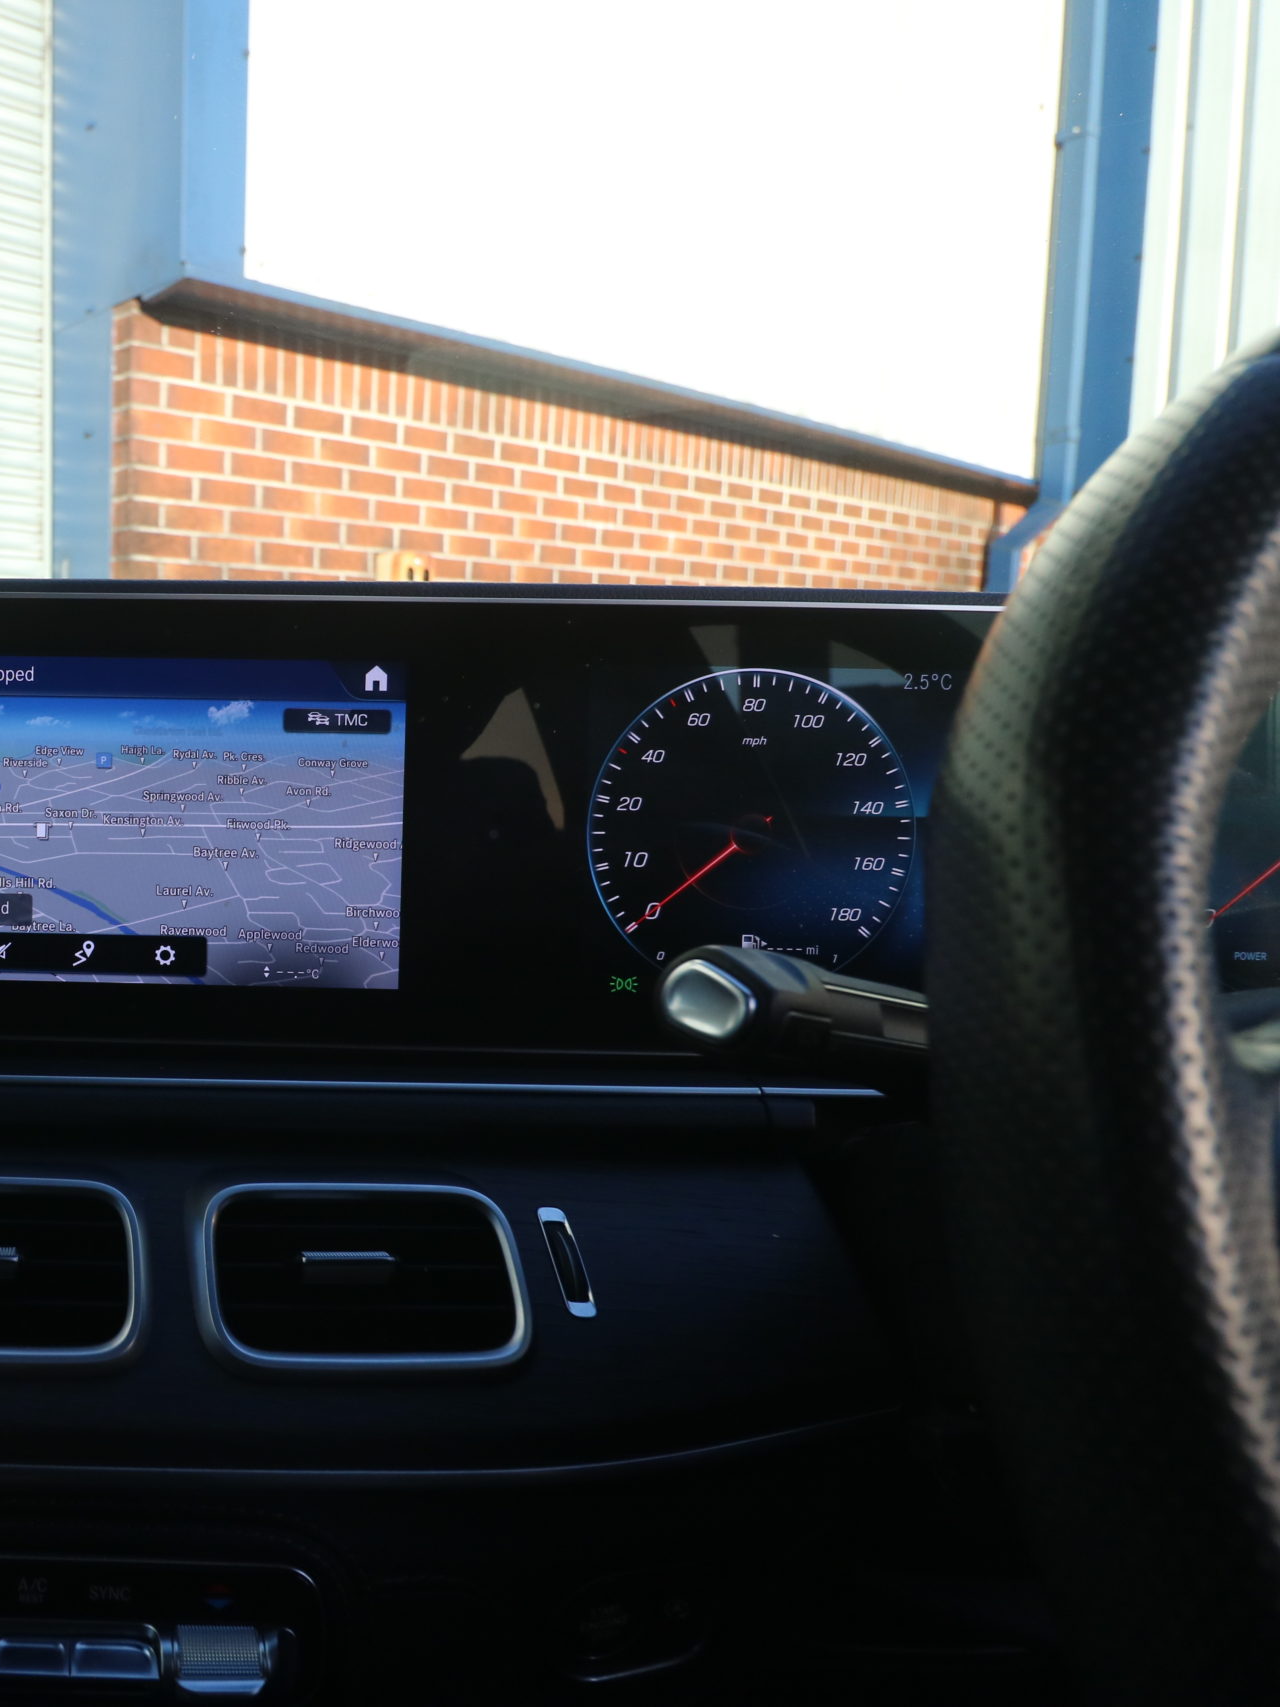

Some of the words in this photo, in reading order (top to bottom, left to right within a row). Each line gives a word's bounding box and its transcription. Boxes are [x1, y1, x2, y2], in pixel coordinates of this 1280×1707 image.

[903, 674, 952, 691] 2.5°C
[742, 698, 766, 712] 80
[335, 713, 368, 727] TMC
[687, 713, 710, 727] 60
[793, 714, 824, 728] 100
[742, 735, 767, 747] mph
[35, 745, 59, 757] Edge
[61, 746, 84, 756] View
[120, 745, 148, 757] Haigh
[151, 745, 165, 756] La.
[172, 749, 199, 761] Rydal
[201, 750, 217, 760] Av.
[223, 751, 238, 761] Pk.
[240, 752, 265, 762] Cres.
[641, 750, 665, 764] 40
[3, 757, 48, 768] Riverside
[298, 758, 336, 770] Conway
[339, 758, 368, 769] Grove
[835, 753, 867, 767] 120
[217, 775, 249, 786] Ribble
[251, 775, 267, 786] Av.
[143, 790, 204, 804] Springwood
[206, 792, 224, 802] Av.
[286, 786, 312, 797] Avon
[315, 786, 332, 797] Rd.
[4, 803, 23, 814] Rd.
[616, 797, 642, 811] 20
[852, 801, 884, 815] 140
[45, 807, 78, 819] Saxon
[80, 808, 97, 819] Dr.
[103, 815, 164, 828] Kensington
[167, 816, 184, 827] Av.
[226, 819, 270, 830] Firwood
[273, 820, 291, 831] Pk.
[334, 838, 397, 851] Ridgewood
[193, 847, 238, 860] Baytree
[241, 848, 259, 858] Av.
[623, 852, 649, 868] 10
[853, 857, 885, 871] 160
[15, 877, 35, 888] Hill
[37, 878, 56, 889] Rd.
[156, 885, 193, 897] Laurel
[195, 886, 214, 897] Av.
[346, 907, 400, 919] Birchwoo
[645, 902, 661, 920] 0
[830, 908, 861, 922] 180
[59, 921, 76, 932] La.
[160, 925, 227, 937] Ravenwood
[238, 928, 302, 942] Applewood
[352, 936, 399, 948] Elderwo
[295, 943, 349, 954] Redwood
[806, 944, 820, 955] mi
[656, 951, 665, 961] 0
[833, 953, 839, 963] 1
[1234, 951, 1267, 961] POWER
[17, 1576, 47, 1592] A/C
[89, 1584, 131, 1601] SYNC
